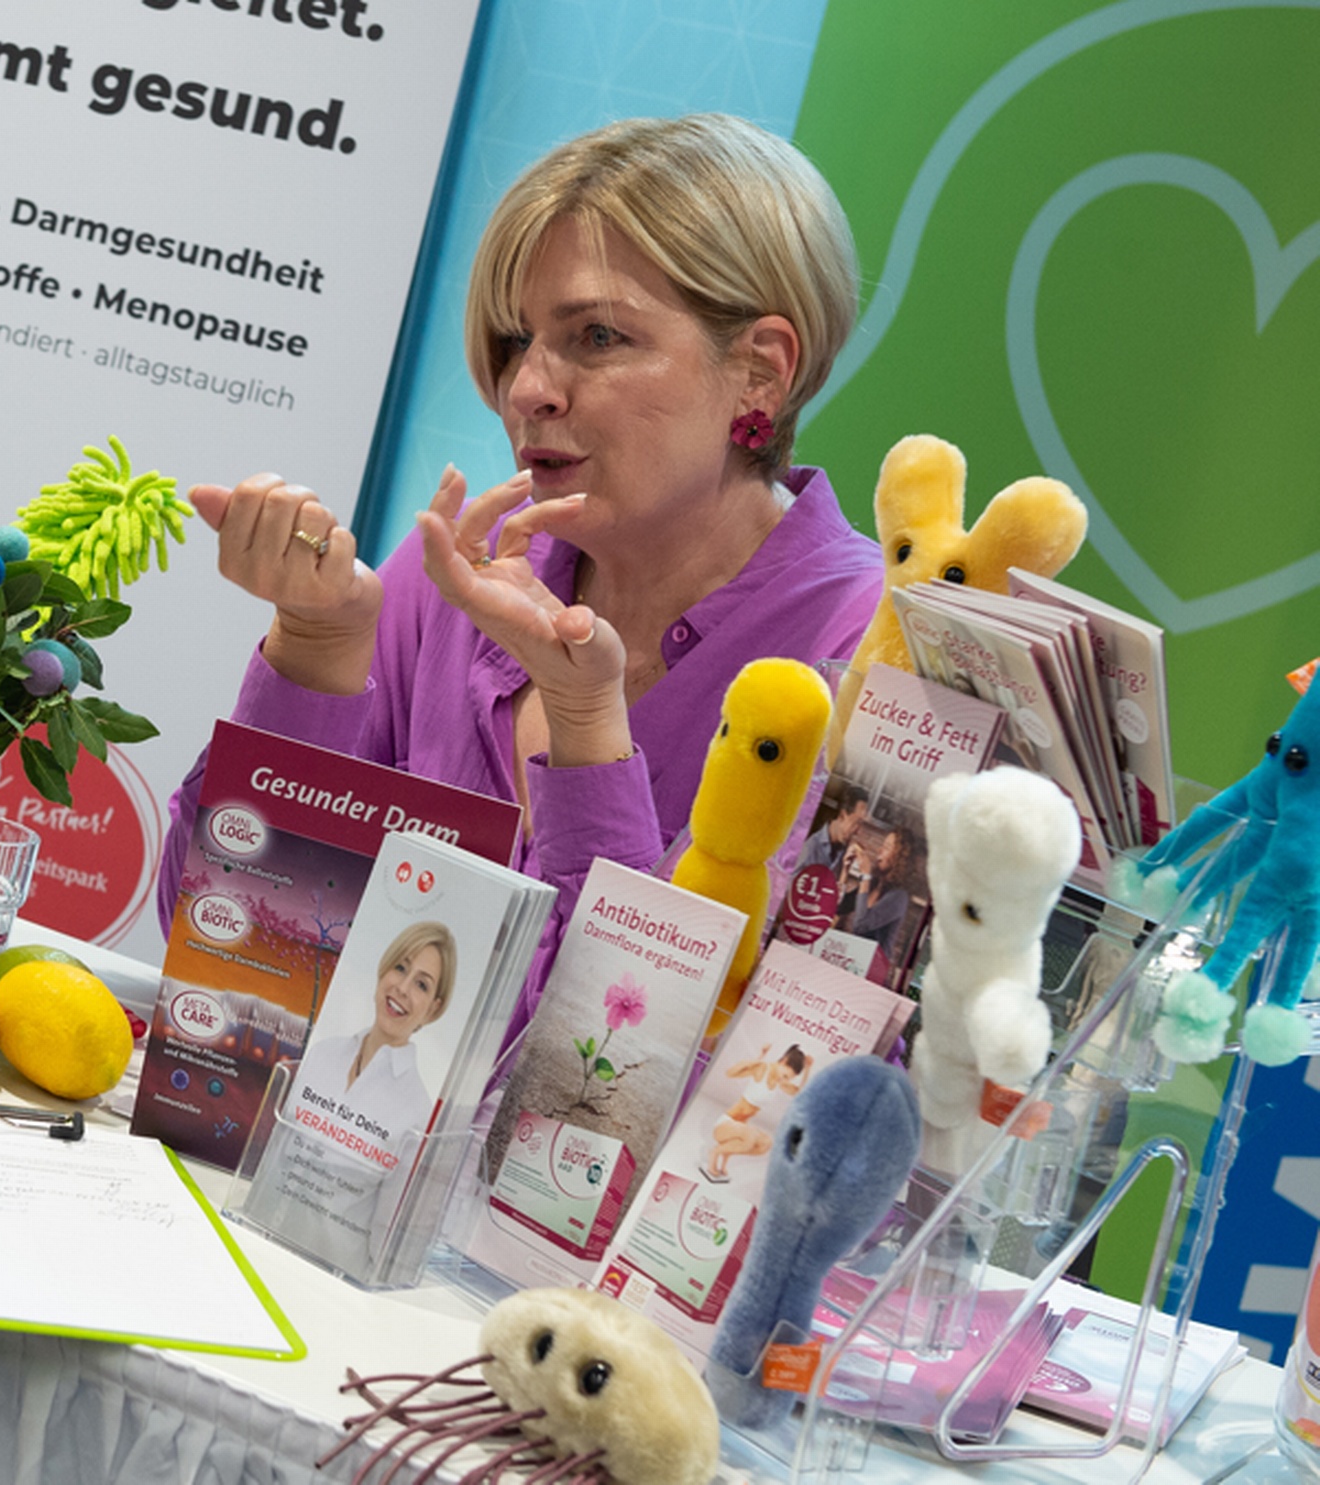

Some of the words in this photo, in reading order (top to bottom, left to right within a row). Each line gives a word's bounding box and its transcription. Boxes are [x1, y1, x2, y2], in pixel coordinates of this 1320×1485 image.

[88, 64, 357, 154] gesund.
[10, 198, 325, 294] Darmgesundheit
[93, 283, 309, 357] Menopause
[93, 346, 296, 411] alltagstauglich
[858, 689, 917, 730] Zucker
[918, 710, 936, 738] &
[938, 721, 980, 756] Fett
[870, 726, 895, 753] im
[897, 738, 945, 773] Griff
[18, 796, 115, 836] Partner!
[250, 766, 379, 823] Gesunder
[583, 921, 644, 957] Darmflora
[645, 949, 705, 982] ergänzen!
[591, 896, 718, 962] Antibiotikum?
[748, 993, 770, 1011] zur
[771, 1000, 861, 1056] Wunschfigur
[761, 968, 783, 993] Mit
[785, 979, 829, 1014] Ihrem
[829, 999, 872, 1034] Darm
[295, 1105, 400, 1171] VERÄNDERUNG?
[301, 1085, 336, 1112] Bereit
[336, 1103, 354, 1122] für
[355, 1113, 390, 1142] Deine
